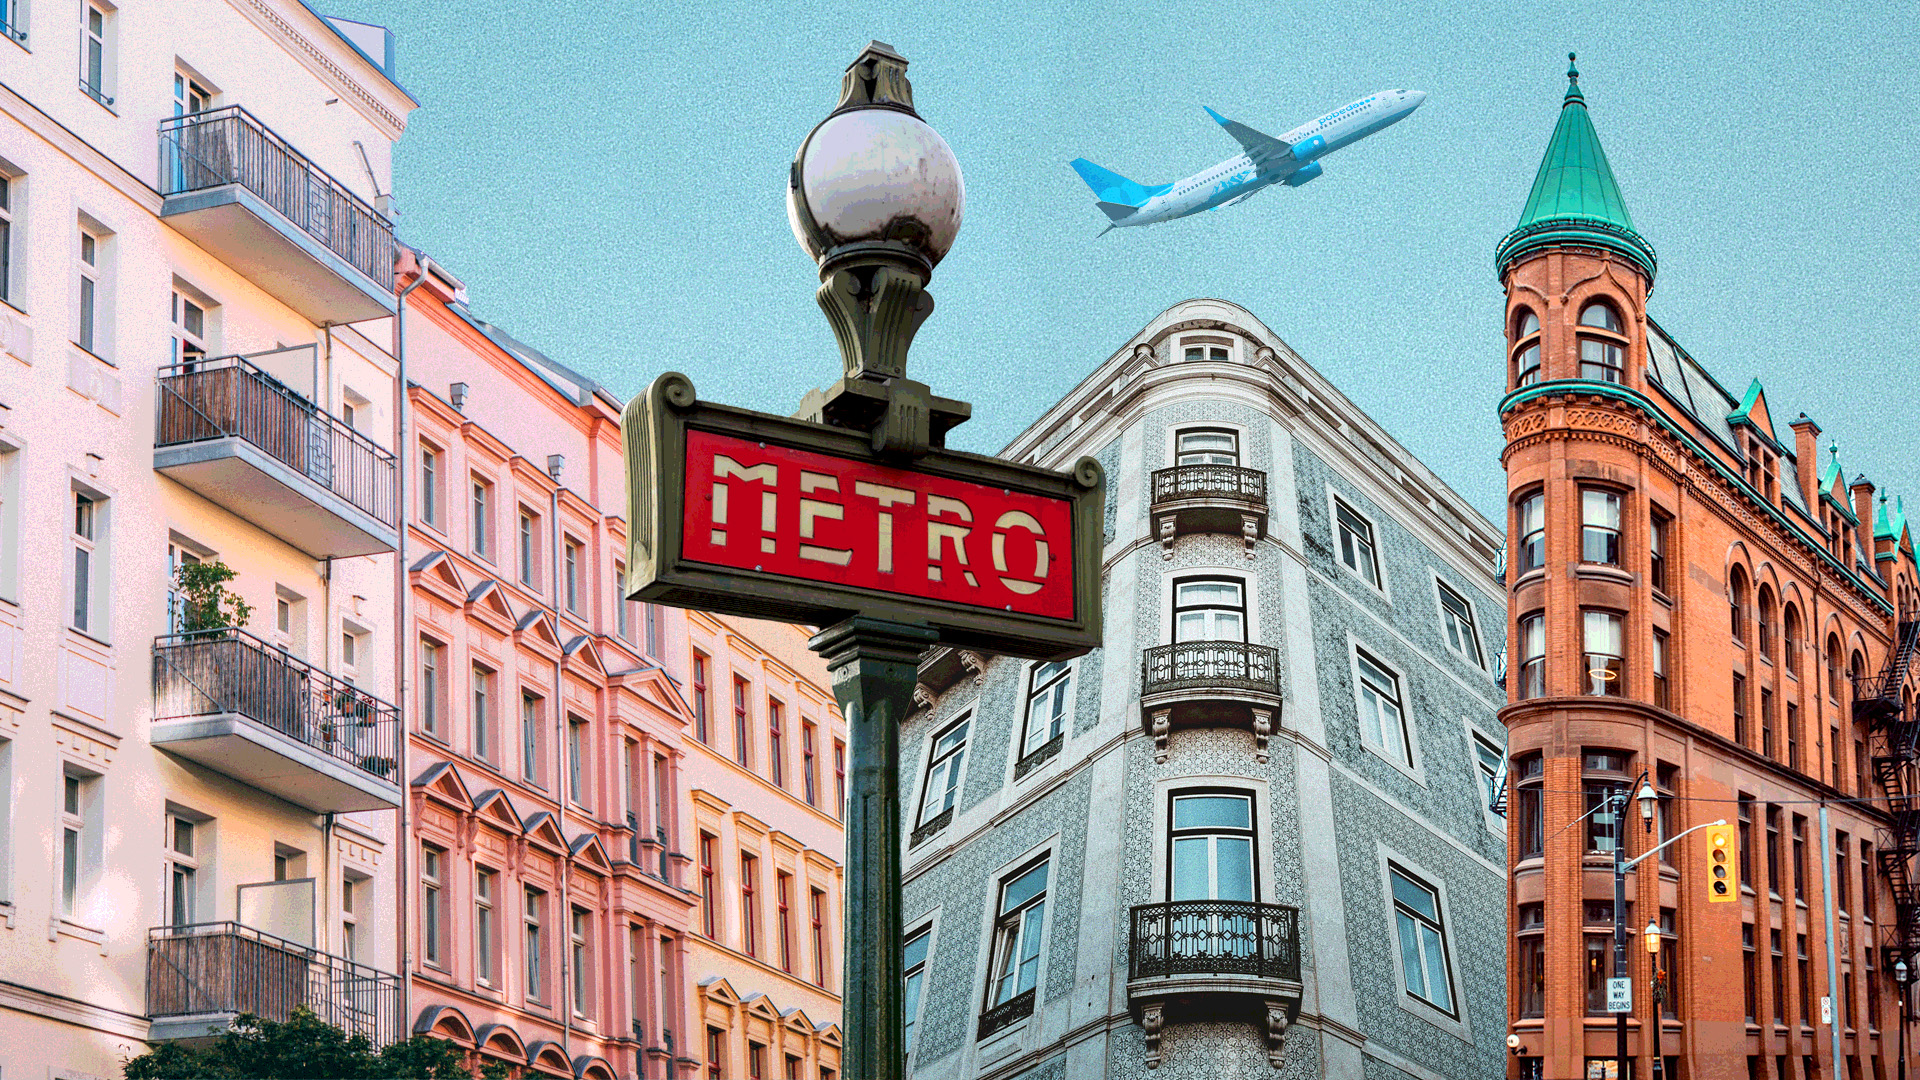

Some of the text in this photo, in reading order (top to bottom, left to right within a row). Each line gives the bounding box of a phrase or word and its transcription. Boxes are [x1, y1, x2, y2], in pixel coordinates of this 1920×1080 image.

[1318, 103, 1360, 125] pobeda
[710, 454, 1050, 595] METRO
[1613, 980, 1625, 989] ONE
[1613, 991, 1625, 999] WAY
[1608, 1001, 1630, 1010] BEGINS
